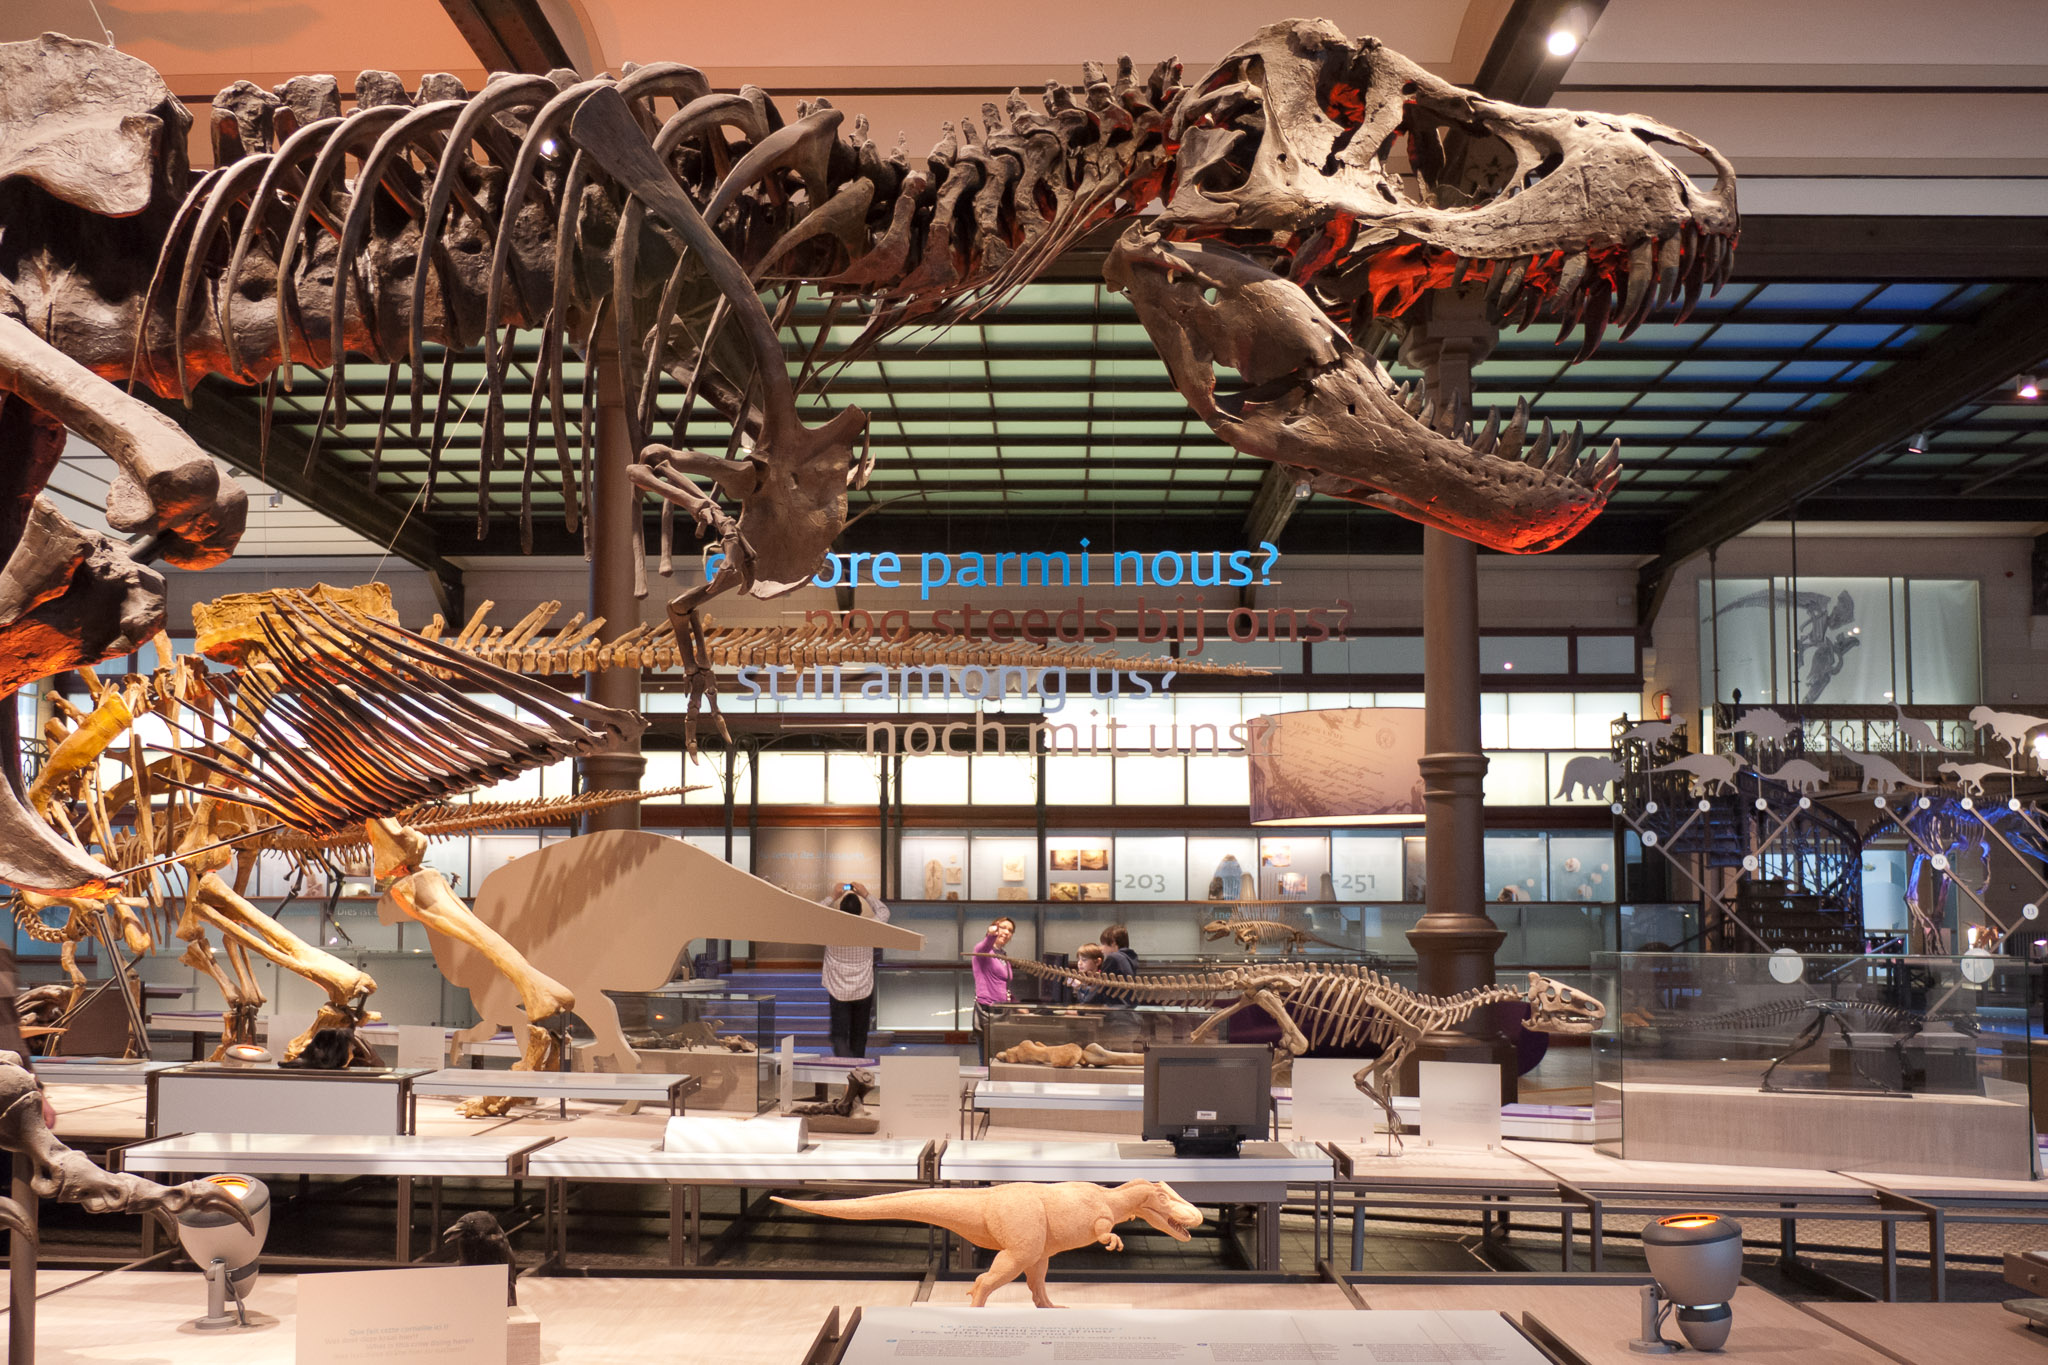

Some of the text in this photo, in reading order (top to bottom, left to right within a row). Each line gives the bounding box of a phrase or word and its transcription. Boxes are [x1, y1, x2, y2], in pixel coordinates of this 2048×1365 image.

[921, 537, 1089, 600] parmi
[1113, 541, 1279, 587] nous?
[931, 596, 1118, 644] steeds
[1137, 593, 1205, 656] bij
[1226, 598, 1356, 644] ons?
[861, 664, 1067, 713] among
[866, 711, 1006, 758] noch
[1029, 709, 1129, 757] mit
[1150, 713, 1278, 758] uns?
